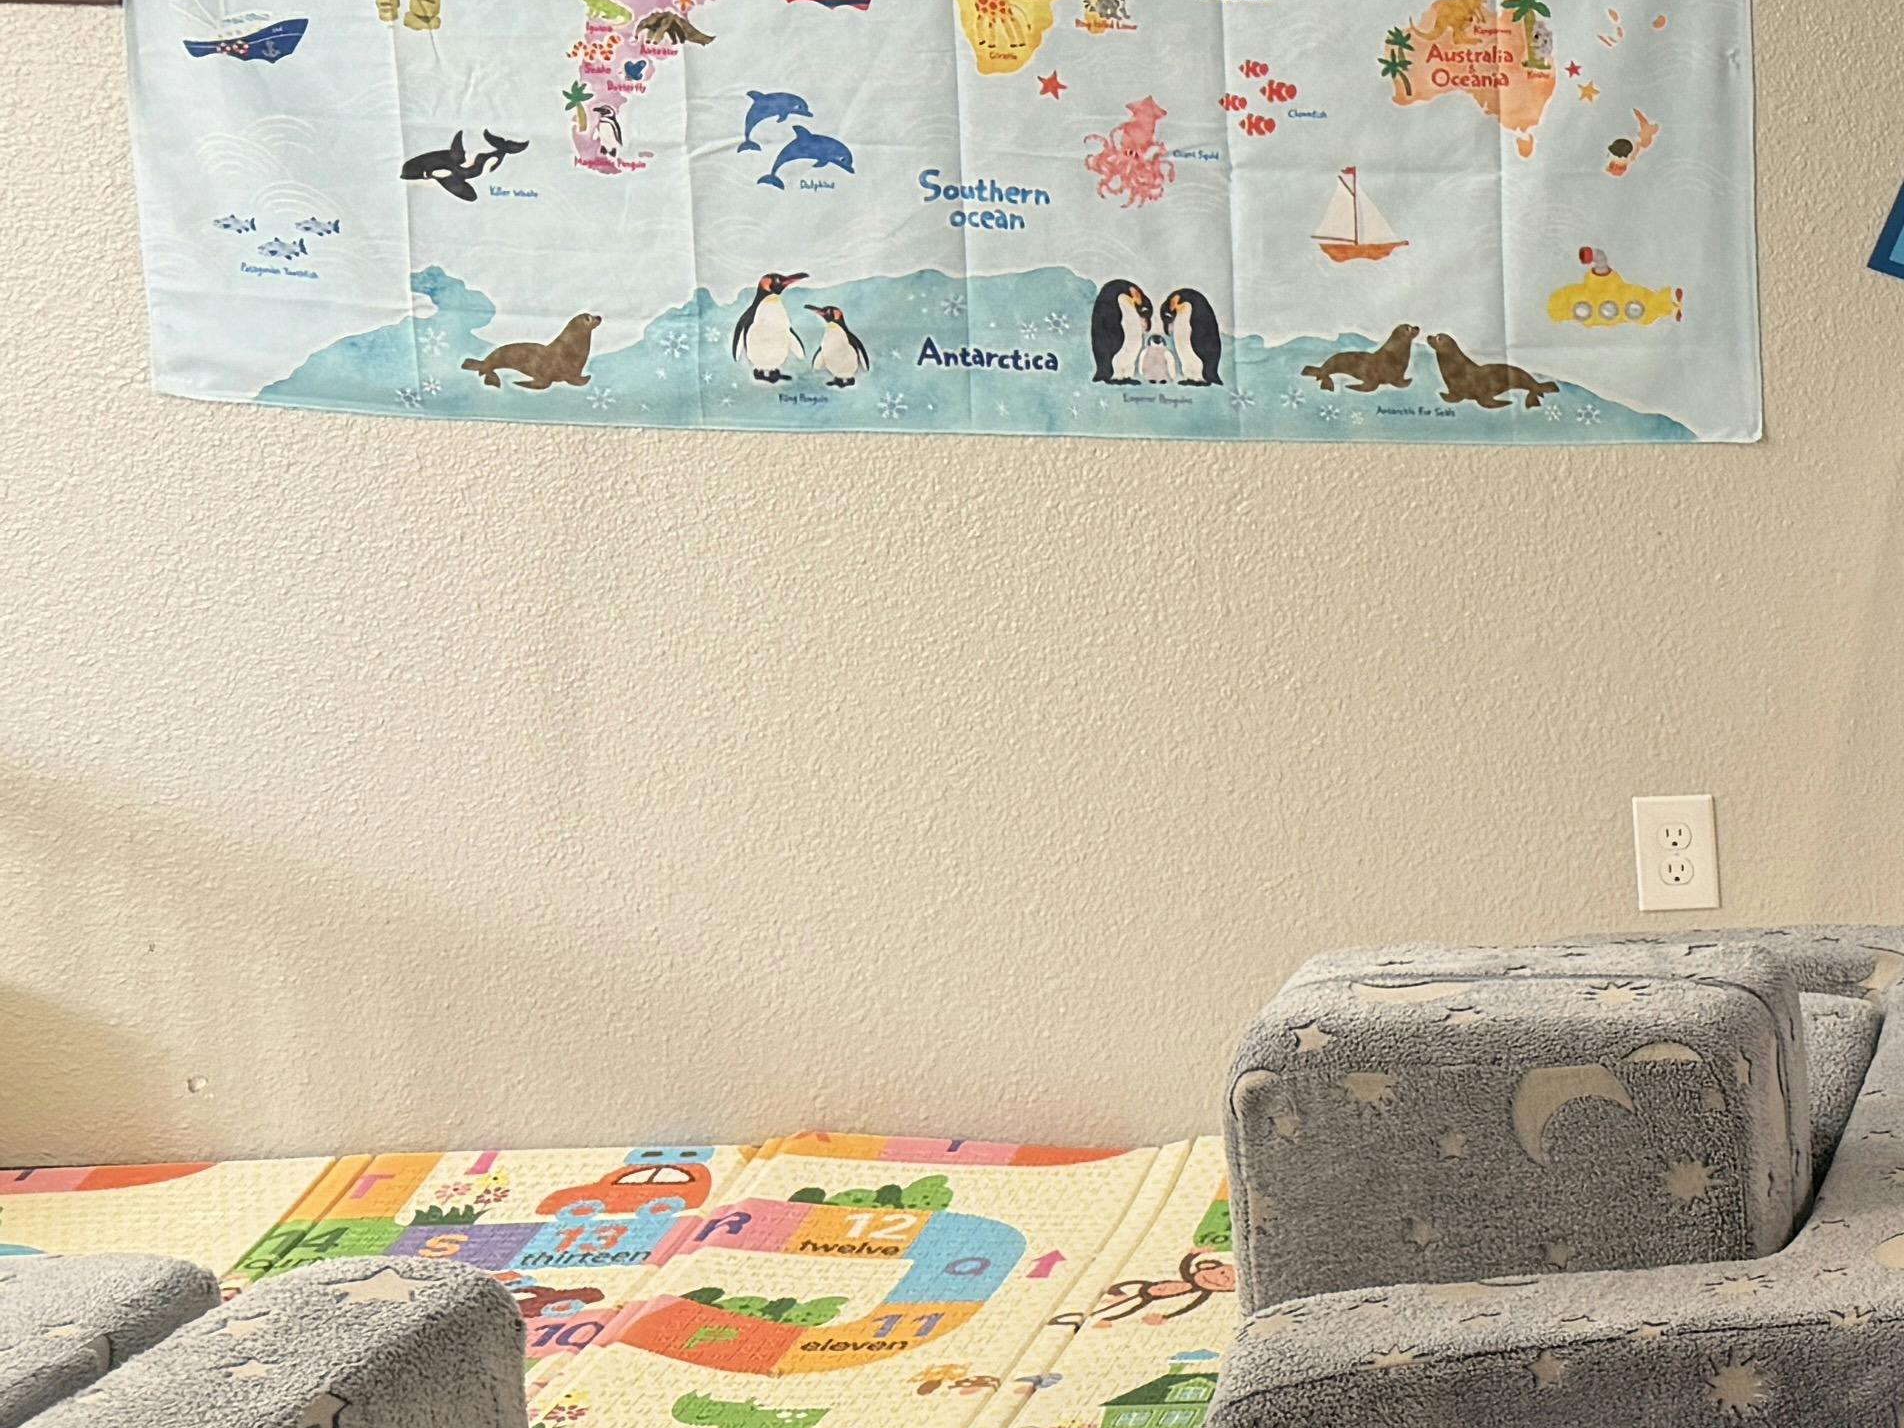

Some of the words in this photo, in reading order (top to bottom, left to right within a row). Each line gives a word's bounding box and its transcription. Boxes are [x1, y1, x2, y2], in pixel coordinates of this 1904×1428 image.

[1426, 43, 1515, 65] Australia
[1431, 71, 1510, 90] Oceania
[918, 170, 1052, 208] Southern
[948, 205, 1027, 232] ocean
[915, 336, 1060, 373] Antarctica
[350, 1173, 396, 1199] T
[554, 1224, 630, 1253] 13
[842, 1213, 920, 1242] 12
[418, 1233, 469, 1259] S
[519, 1248, 652, 1269] thirteen
[799, 1238, 902, 1259] twelve
[530, 1320, 604, 1350] 10
[869, 1313, 946, 1338] 11
[800, 1338, 909, 1354] eleven
